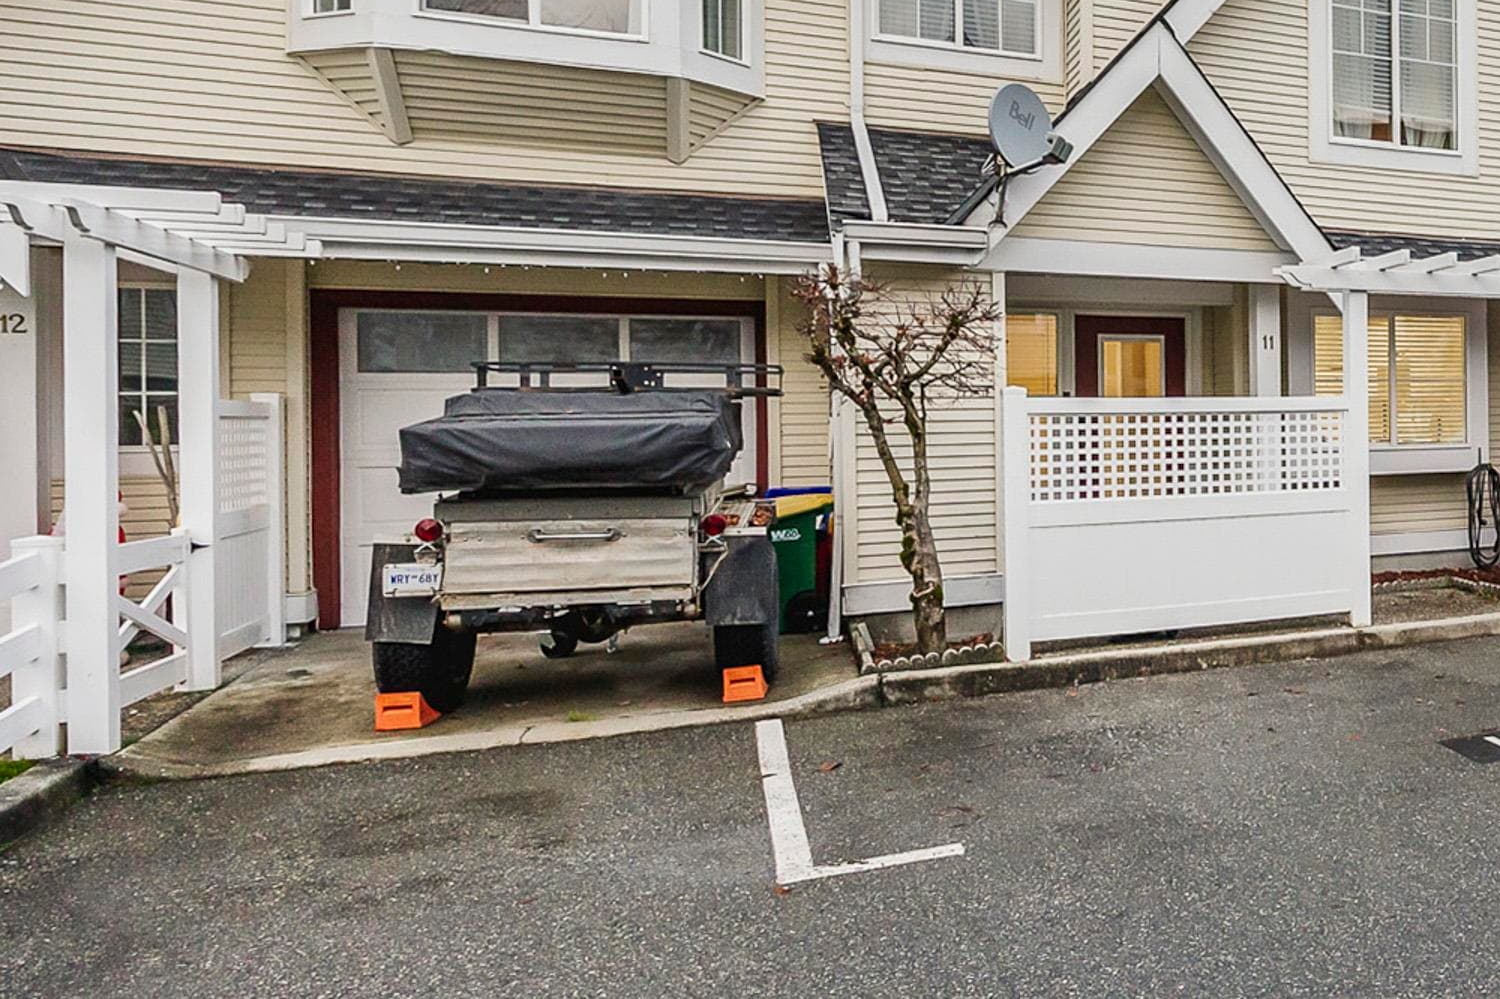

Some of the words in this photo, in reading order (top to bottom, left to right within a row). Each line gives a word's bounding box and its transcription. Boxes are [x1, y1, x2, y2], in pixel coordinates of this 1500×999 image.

[1009, 100, 1035, 130] Bell
[0, 313, 27, 333] 12
[1262, 335, 1274, 350] 11
